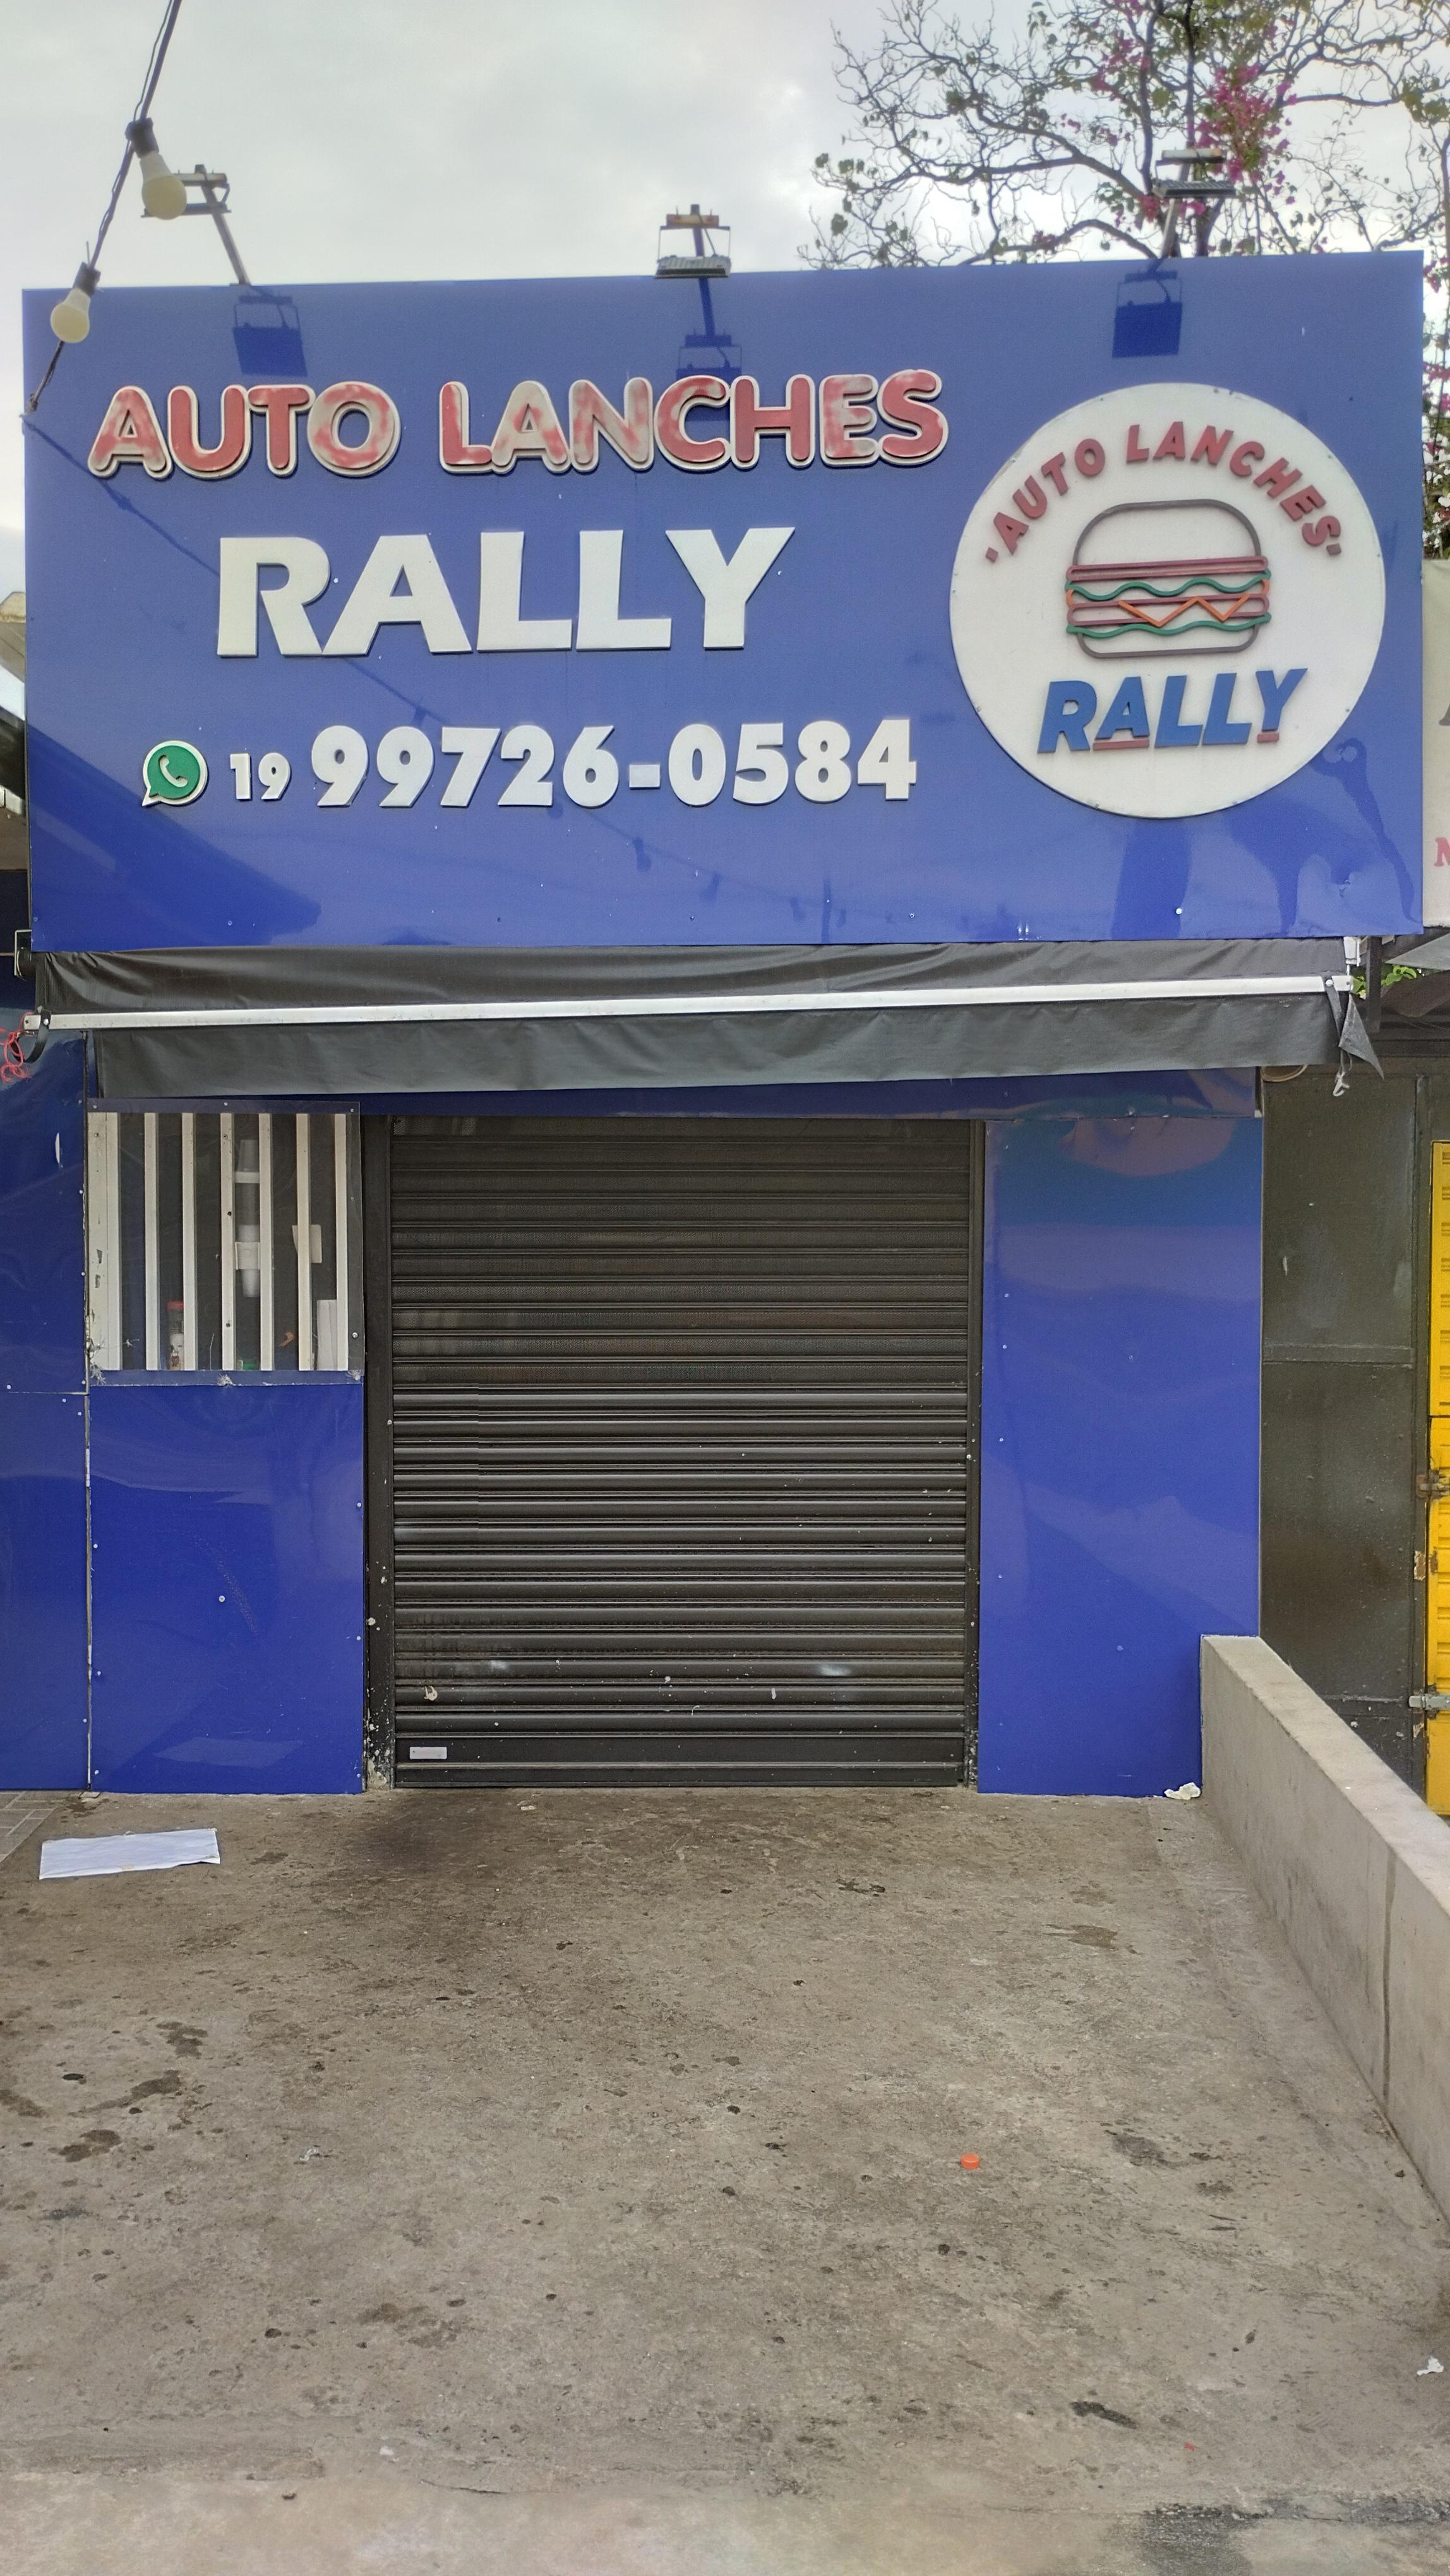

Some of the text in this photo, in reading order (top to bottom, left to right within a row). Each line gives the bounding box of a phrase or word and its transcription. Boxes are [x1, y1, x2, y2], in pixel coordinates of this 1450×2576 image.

[88, 369, 949, 478] AUTO LANCHES
[993, 421, 1341, 555] AUTO LANCHES
[217, 527, 796, 657] RALLY
[230, 718, 917, 808] 19 99726-0584
[1038, 667, 1308, 754] RALLY
